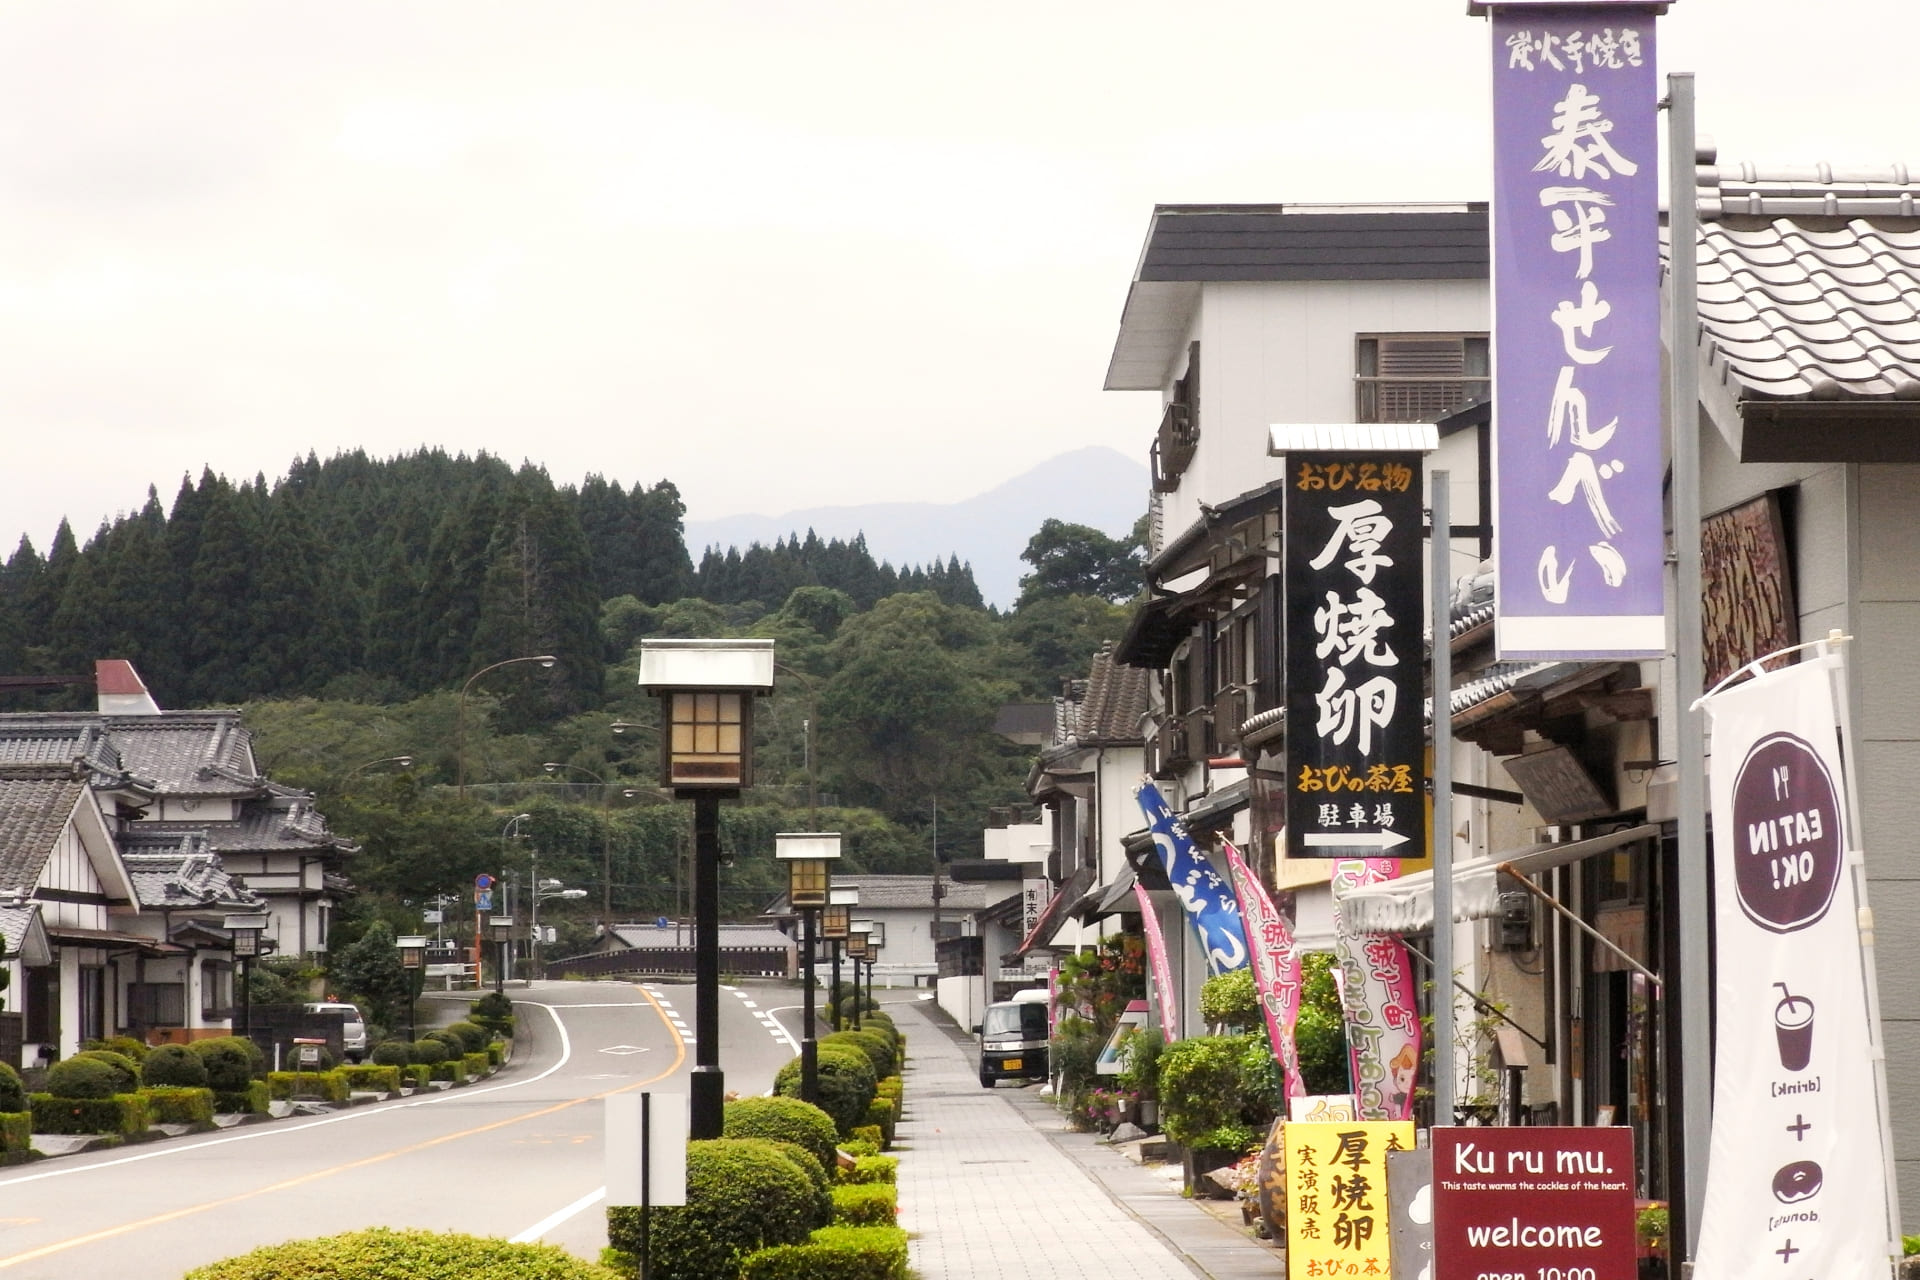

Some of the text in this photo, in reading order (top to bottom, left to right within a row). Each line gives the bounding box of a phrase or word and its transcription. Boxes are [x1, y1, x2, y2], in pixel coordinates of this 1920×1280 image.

[1530, 83, 1638, 605] 泰平せんべい
[1297, 463, 1412, 492] おび名物
[1309, 498, 1399, 757] 厚焼卵
[1297, 764, 1414, 793] おびの茶屋
[1318, 802, 1395, 829] 駐車場
[1455, 1142, 1613, 1174] Ku ru mu.
[1297, 1145, 1321, 1240] 実演販売
[1328, 1130, 1375, 1251] 厚焼卵
[1442, 1181, 1628, 1190] This taste warms the cockles of the heart.
[1467, 1217, 1603, 1248] welcome
[1306, 1257, 1391, 1277] おびの茶
